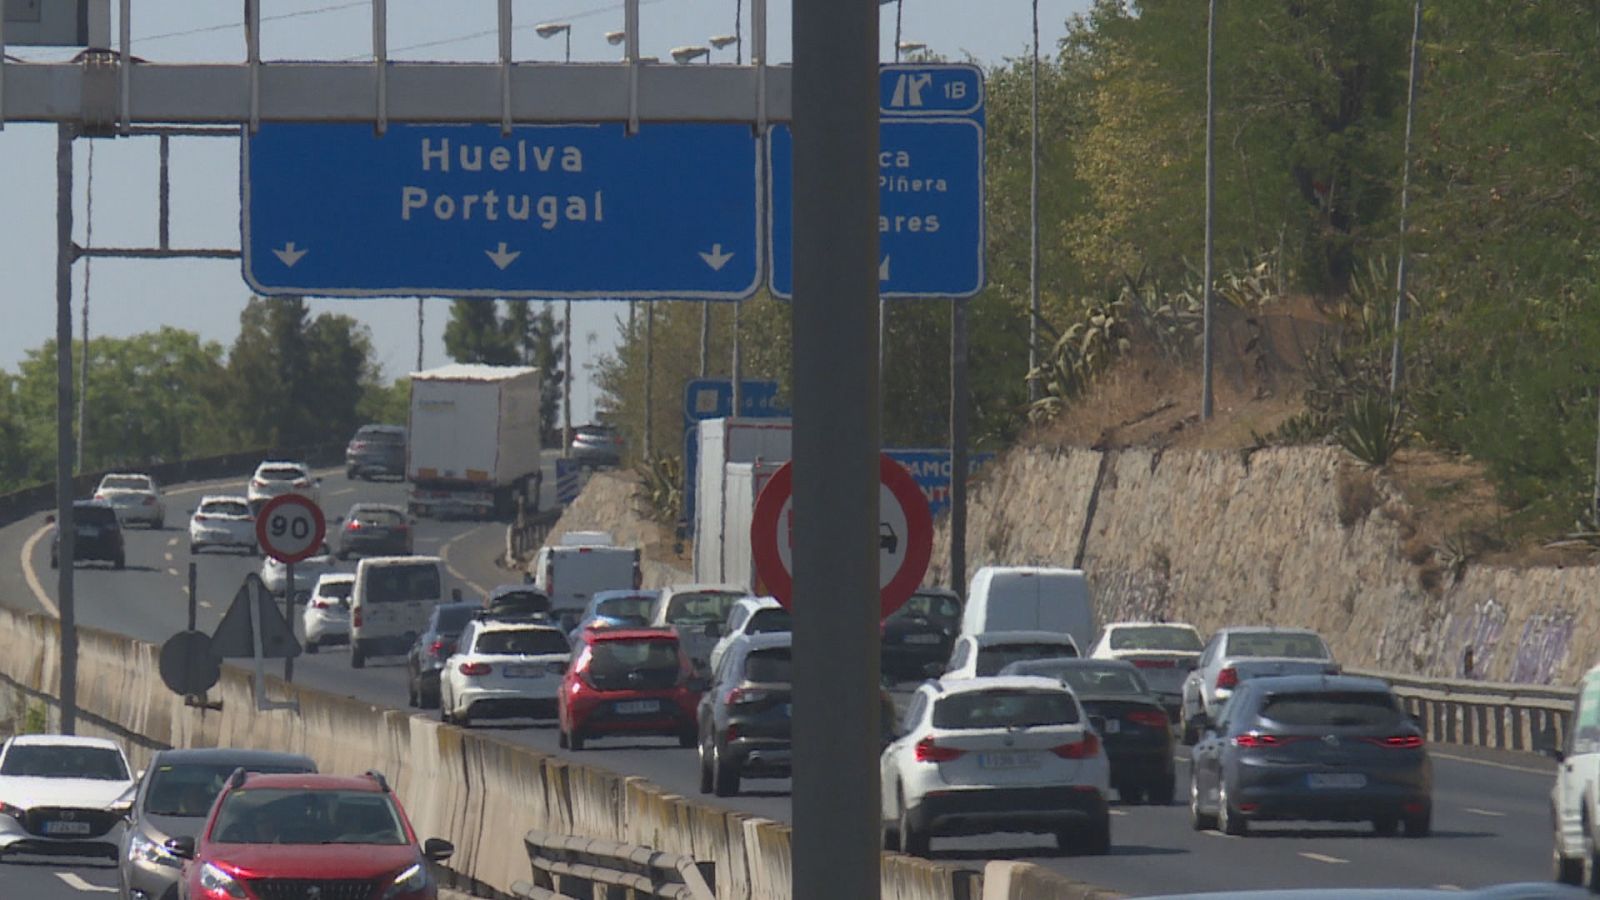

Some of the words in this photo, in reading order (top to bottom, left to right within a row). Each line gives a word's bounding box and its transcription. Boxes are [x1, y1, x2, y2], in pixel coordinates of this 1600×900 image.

[943, 81, 966, 99] 1B
[421, 138, 583, 172] Huelva
[879, 151, 910, 168] ca
[401, 186, 604, 230] Portugal
[879, 214, 941, 232] ares
[271, 514, 309, 540] 90
